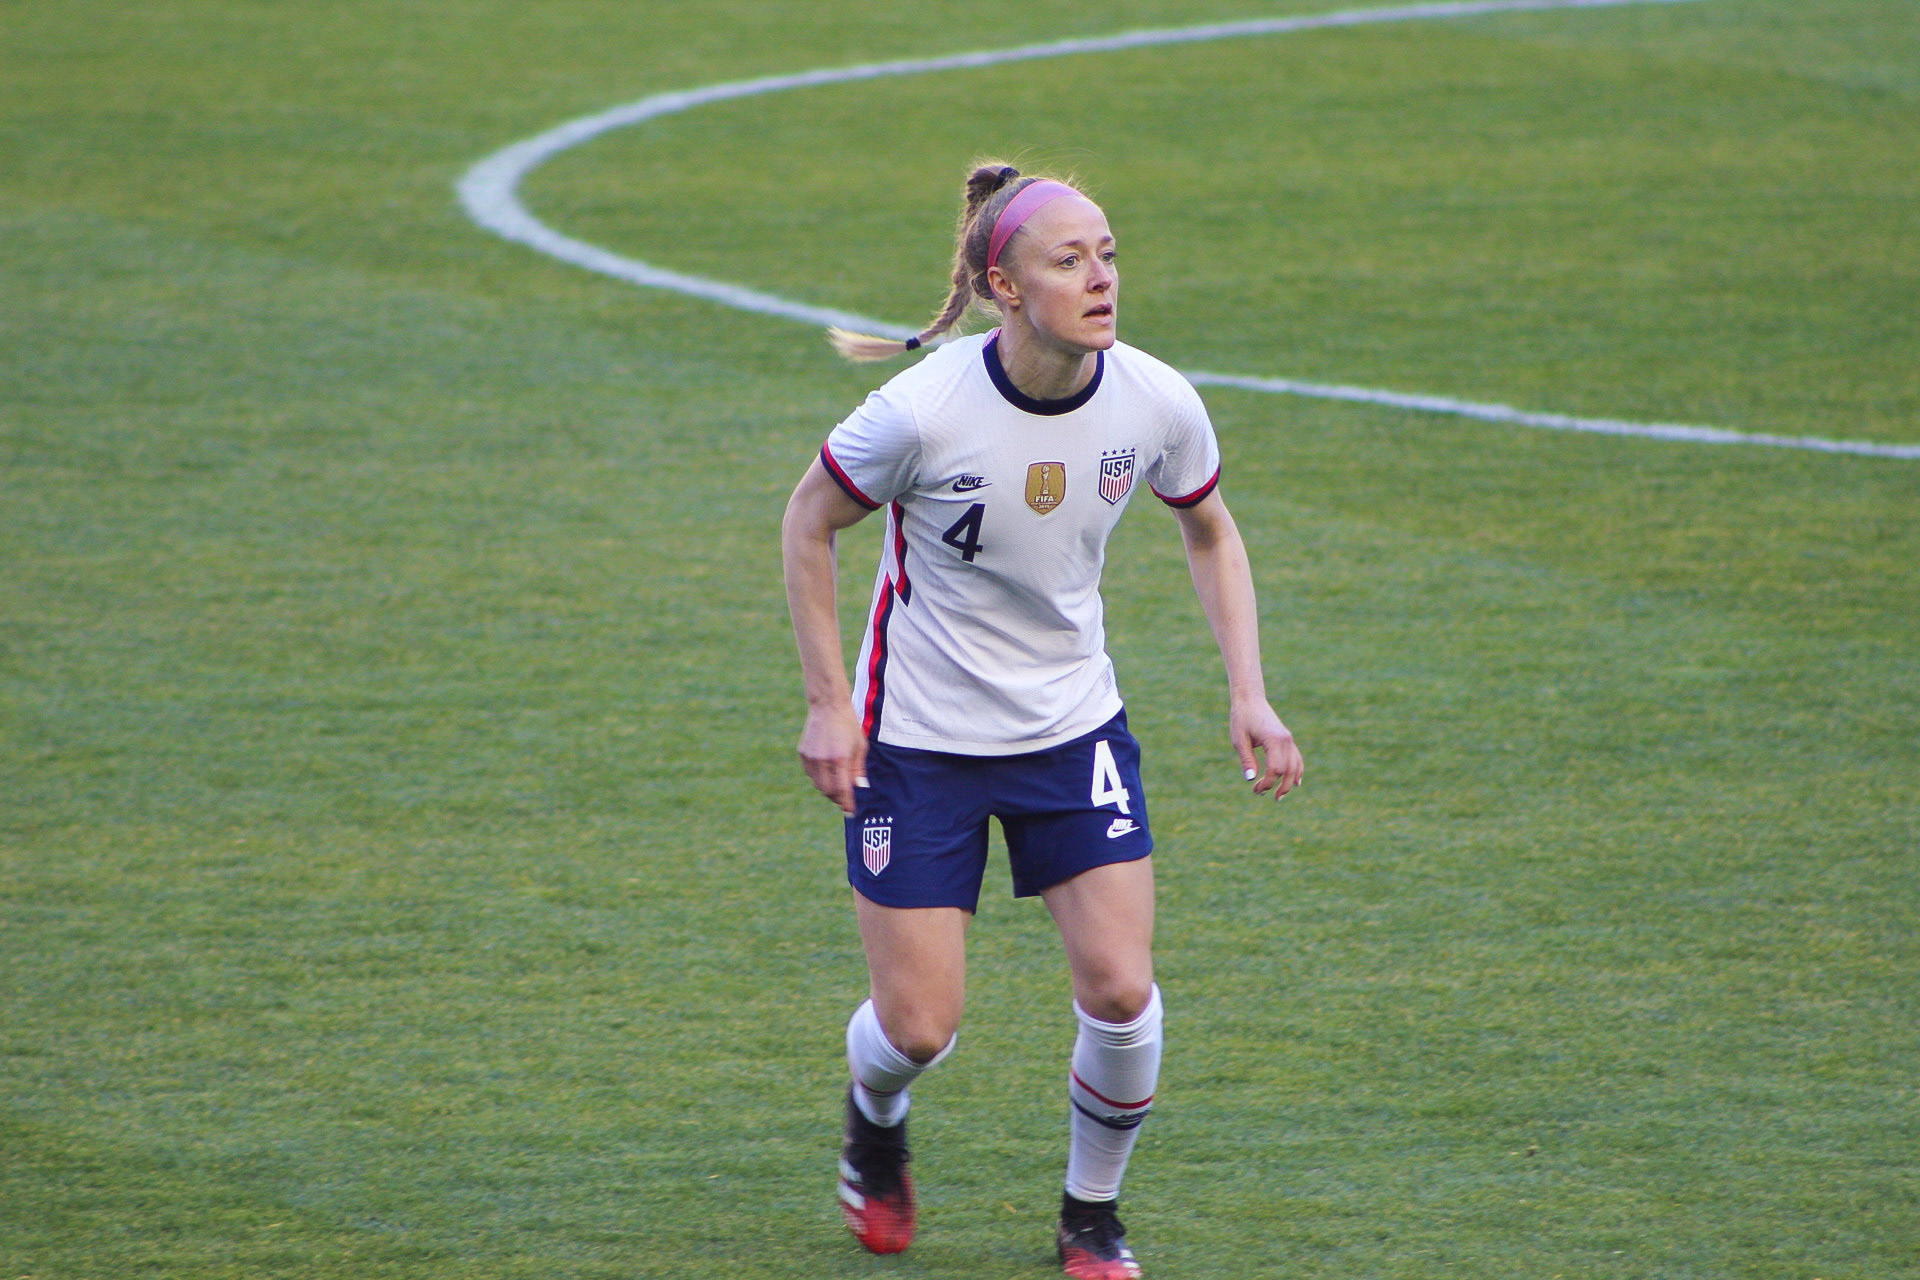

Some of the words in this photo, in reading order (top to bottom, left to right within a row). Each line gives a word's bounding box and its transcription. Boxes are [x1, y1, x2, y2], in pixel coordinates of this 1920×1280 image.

[1104, 460, 1131, 478] USA
[958, 475, 984, 487] NIKE
[1034, 495, 1054, 503] FIFA
[942, 503, 985, 562] 4
[1091, 740, 1130, 815] 4
[1112, 818, 1133, 830] NIKE
[864, 829, 889, 848] USA
